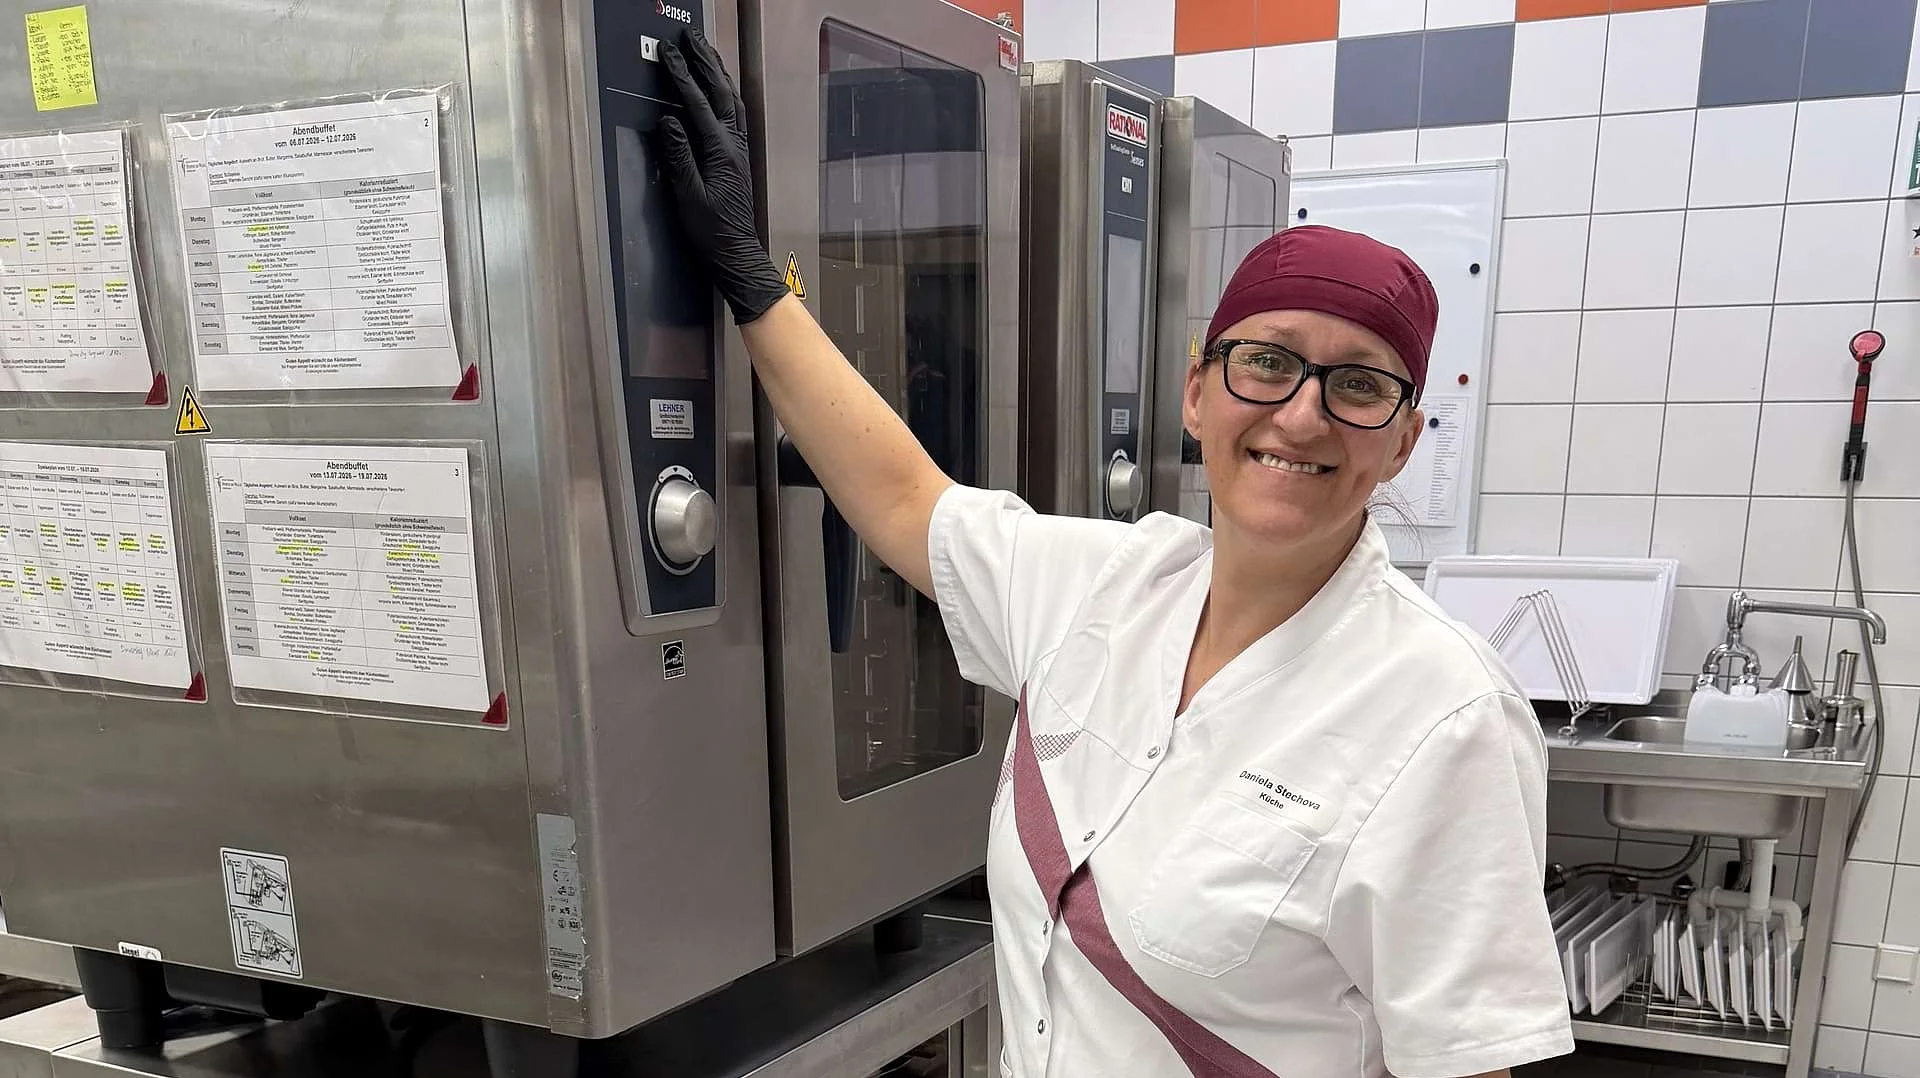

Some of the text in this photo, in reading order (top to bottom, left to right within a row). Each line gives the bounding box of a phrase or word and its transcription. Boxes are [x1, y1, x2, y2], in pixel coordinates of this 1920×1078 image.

[424, 118, 429, 127] 2
[1110, 111, 1146, 140] RATIONAL
[293, 124, 336, 135] Abendbuffet
[659, 403, 685, 413] LEHNER
[327, 462, 368, 470] Abendbuffet
[455, 468, 459, 476] 3
[226, 549, 244, 557] Dienstag
[228, 588, 250, 596] Donnerstag
[1239, 770, 1320, 810] Daniela Stechova
[1259, 792, 1284, 809] Küche
